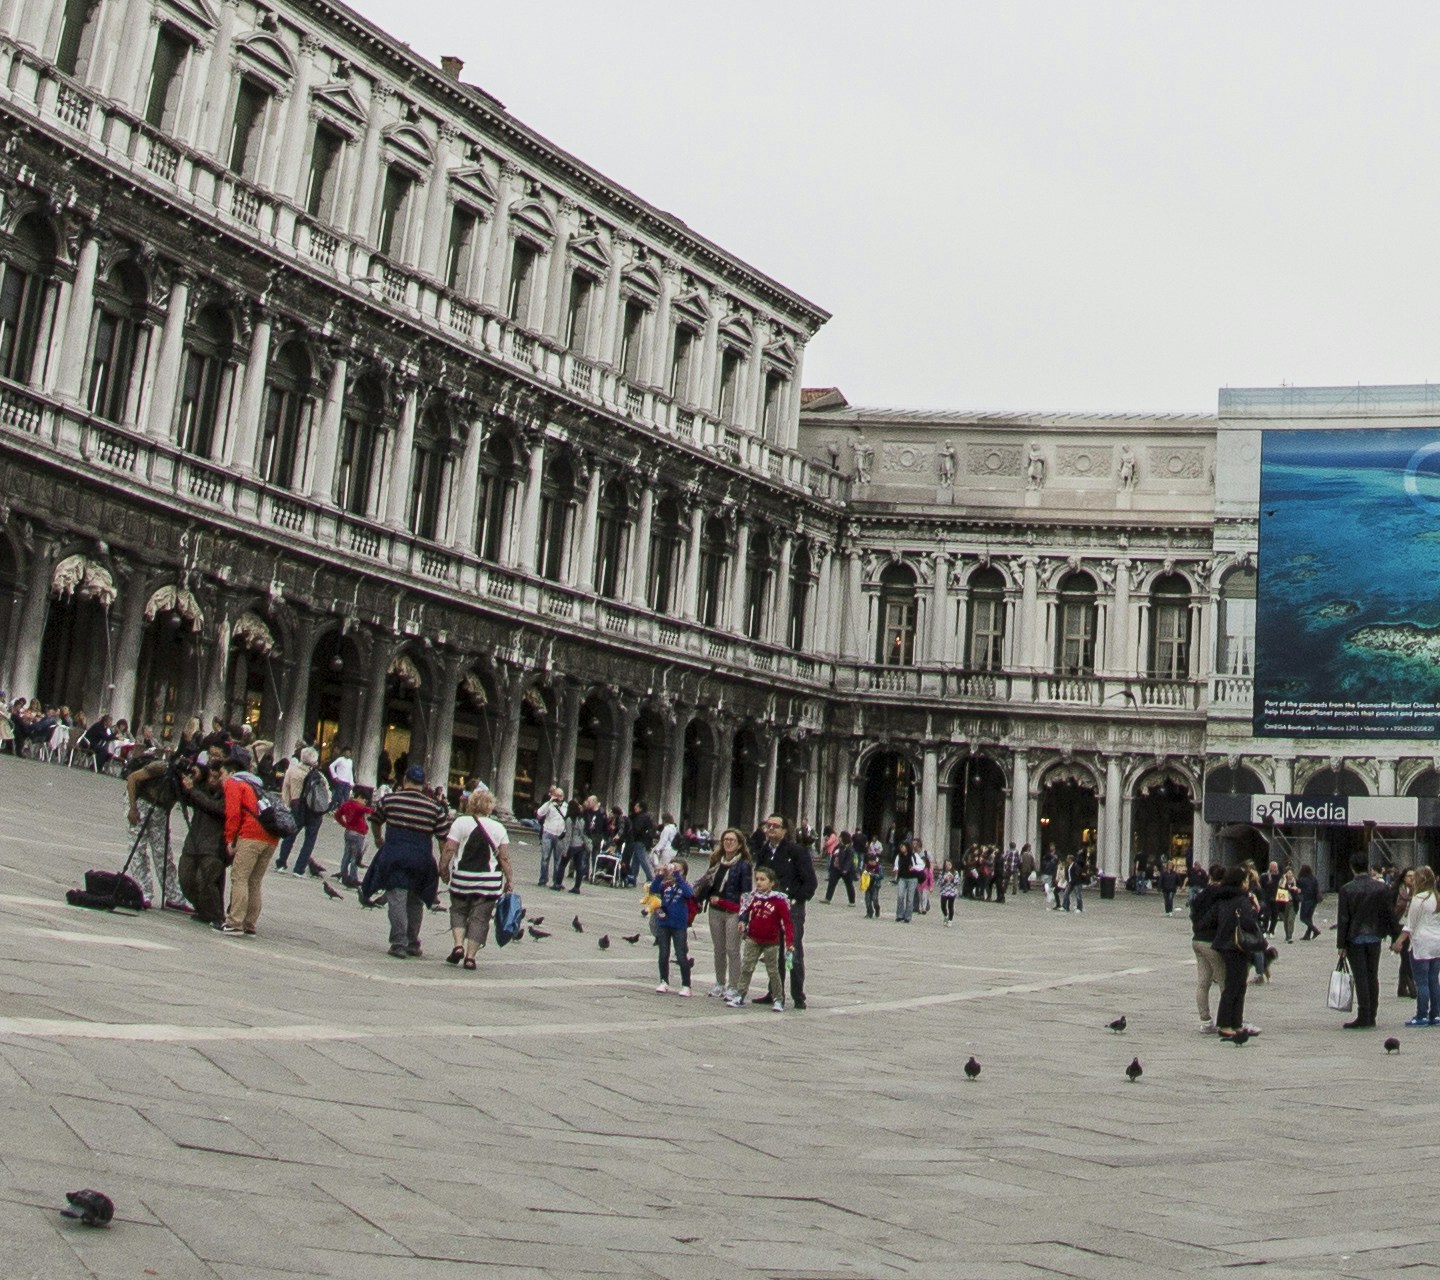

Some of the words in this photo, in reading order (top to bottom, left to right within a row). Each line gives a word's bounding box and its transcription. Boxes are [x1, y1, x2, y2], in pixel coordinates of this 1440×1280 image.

[1264, 700, 1279, 708] Part
[1279, 700, 1287, 708] of
[1299, 701, 1327, 709] proceeds
[1345, 701, 1356, 709] the
[1391, 701, 1412, 709] Planet
[1413, 701, 1435, 709] Ocean
[1264, 709, 1278, 717] help
[1334, 710, 1360, 718] projects
[1375, 710, 1399, 718] protect
[1285, 801, 1346, 820] Media
